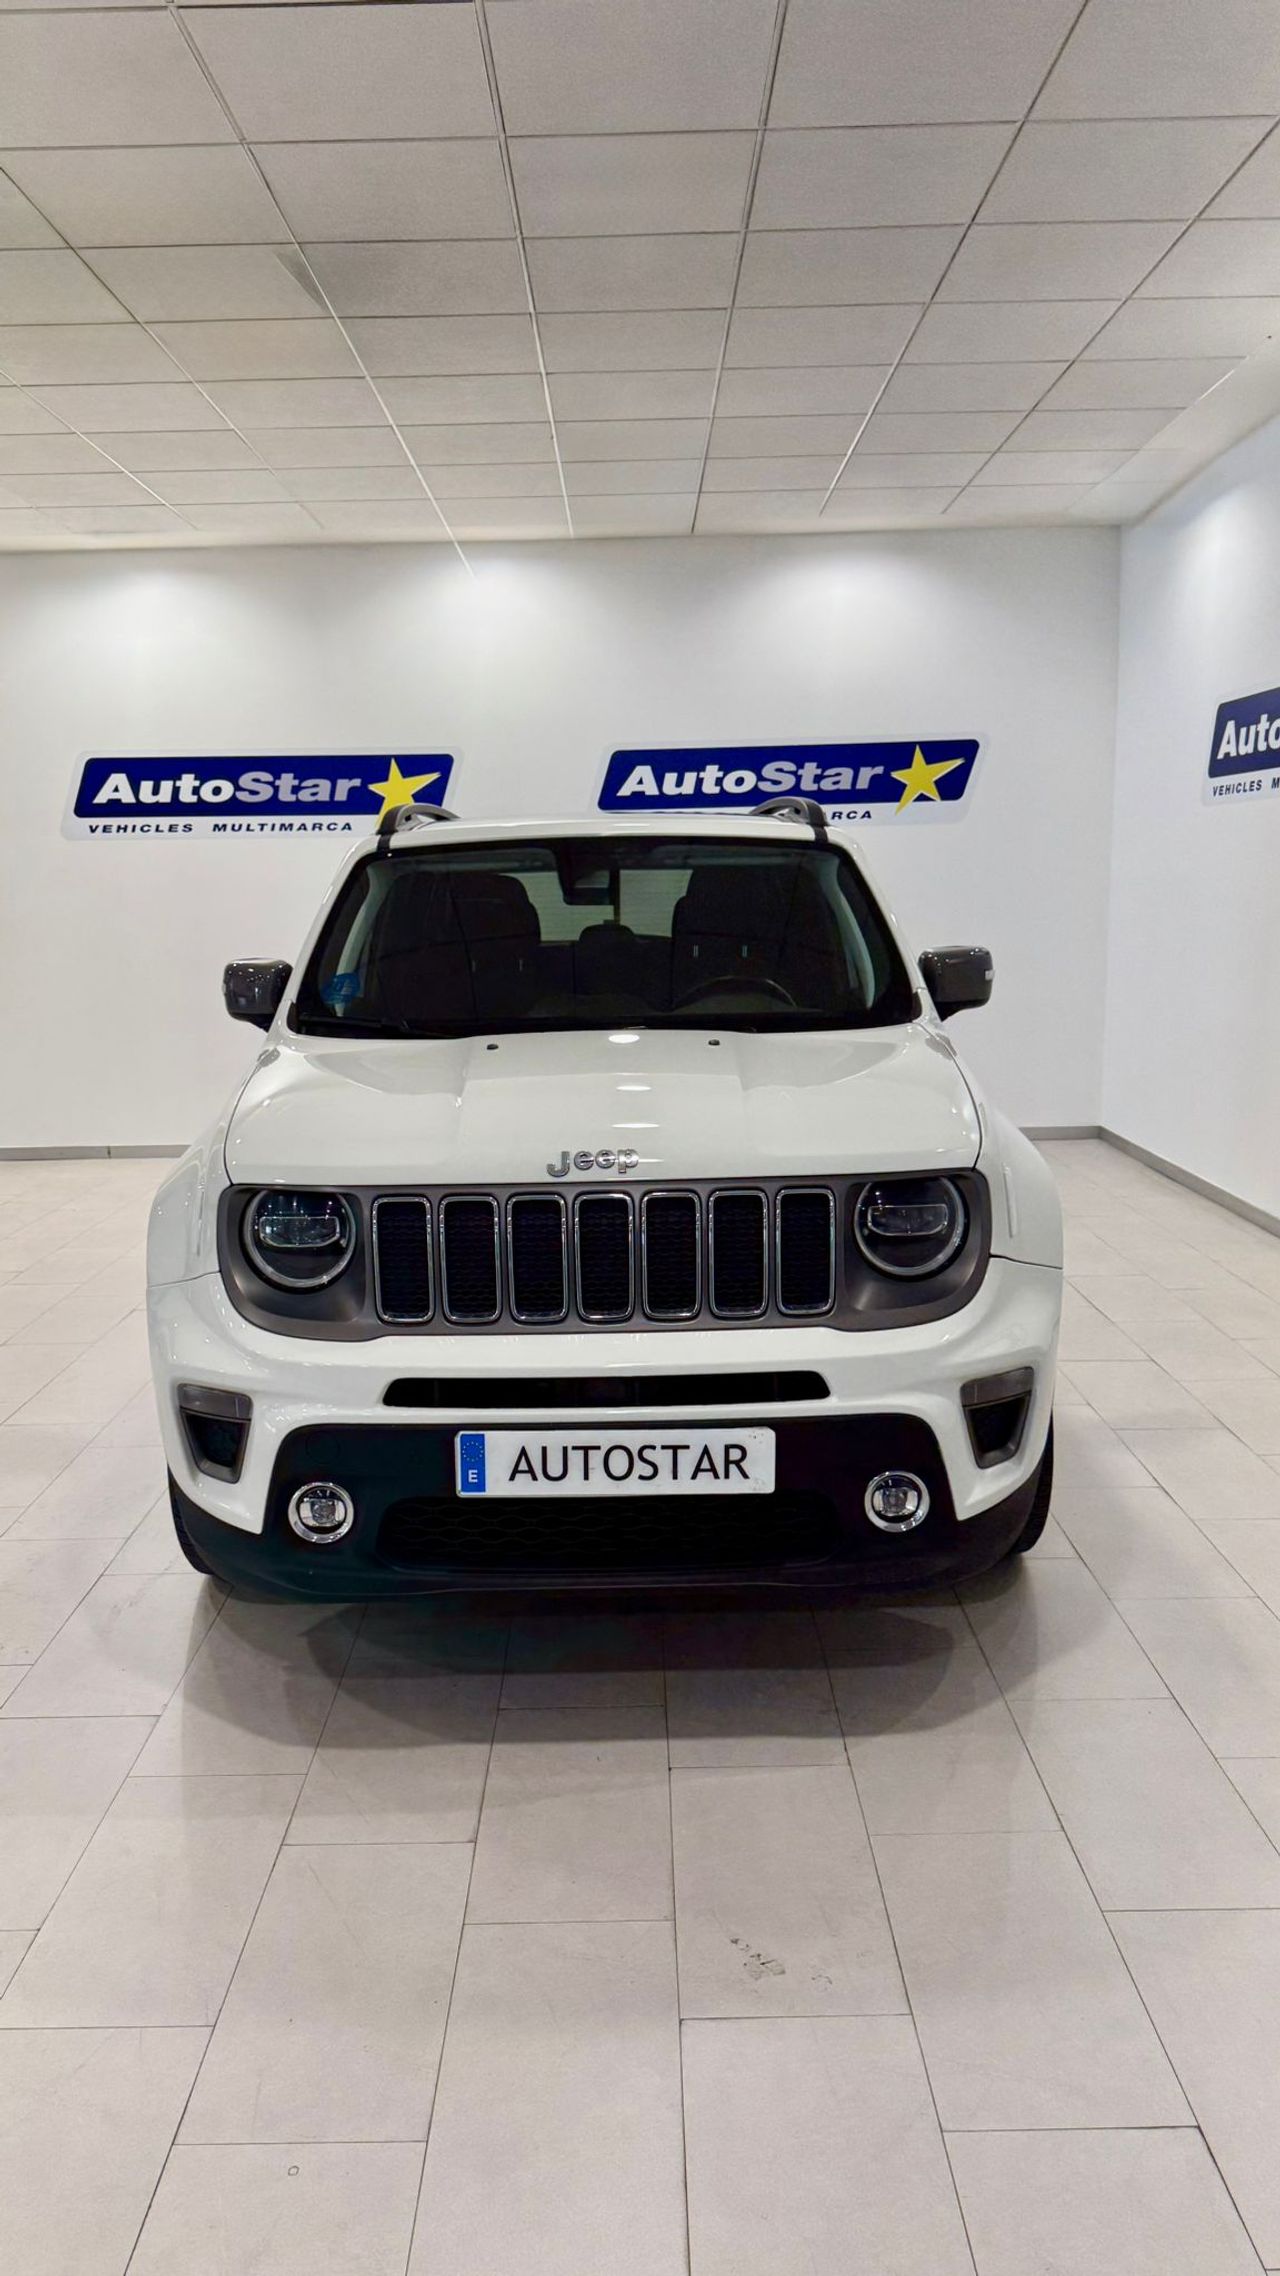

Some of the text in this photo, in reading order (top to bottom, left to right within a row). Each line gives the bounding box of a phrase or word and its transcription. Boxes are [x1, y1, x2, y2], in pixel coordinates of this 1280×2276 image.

[92, 771, 361, 804] AutoStar
[616, 761, 883, 796] AutoStar
[1212, 780, 1262, 797] VEHICLES
[88, 822, 353, 833] VEHICLES MULTIMARCA
[546, 1148, 639, 1178] Jeep
[468, 1470, 478, 1483] E
[508, 1444, 750, 1482] AUTOSTAR
